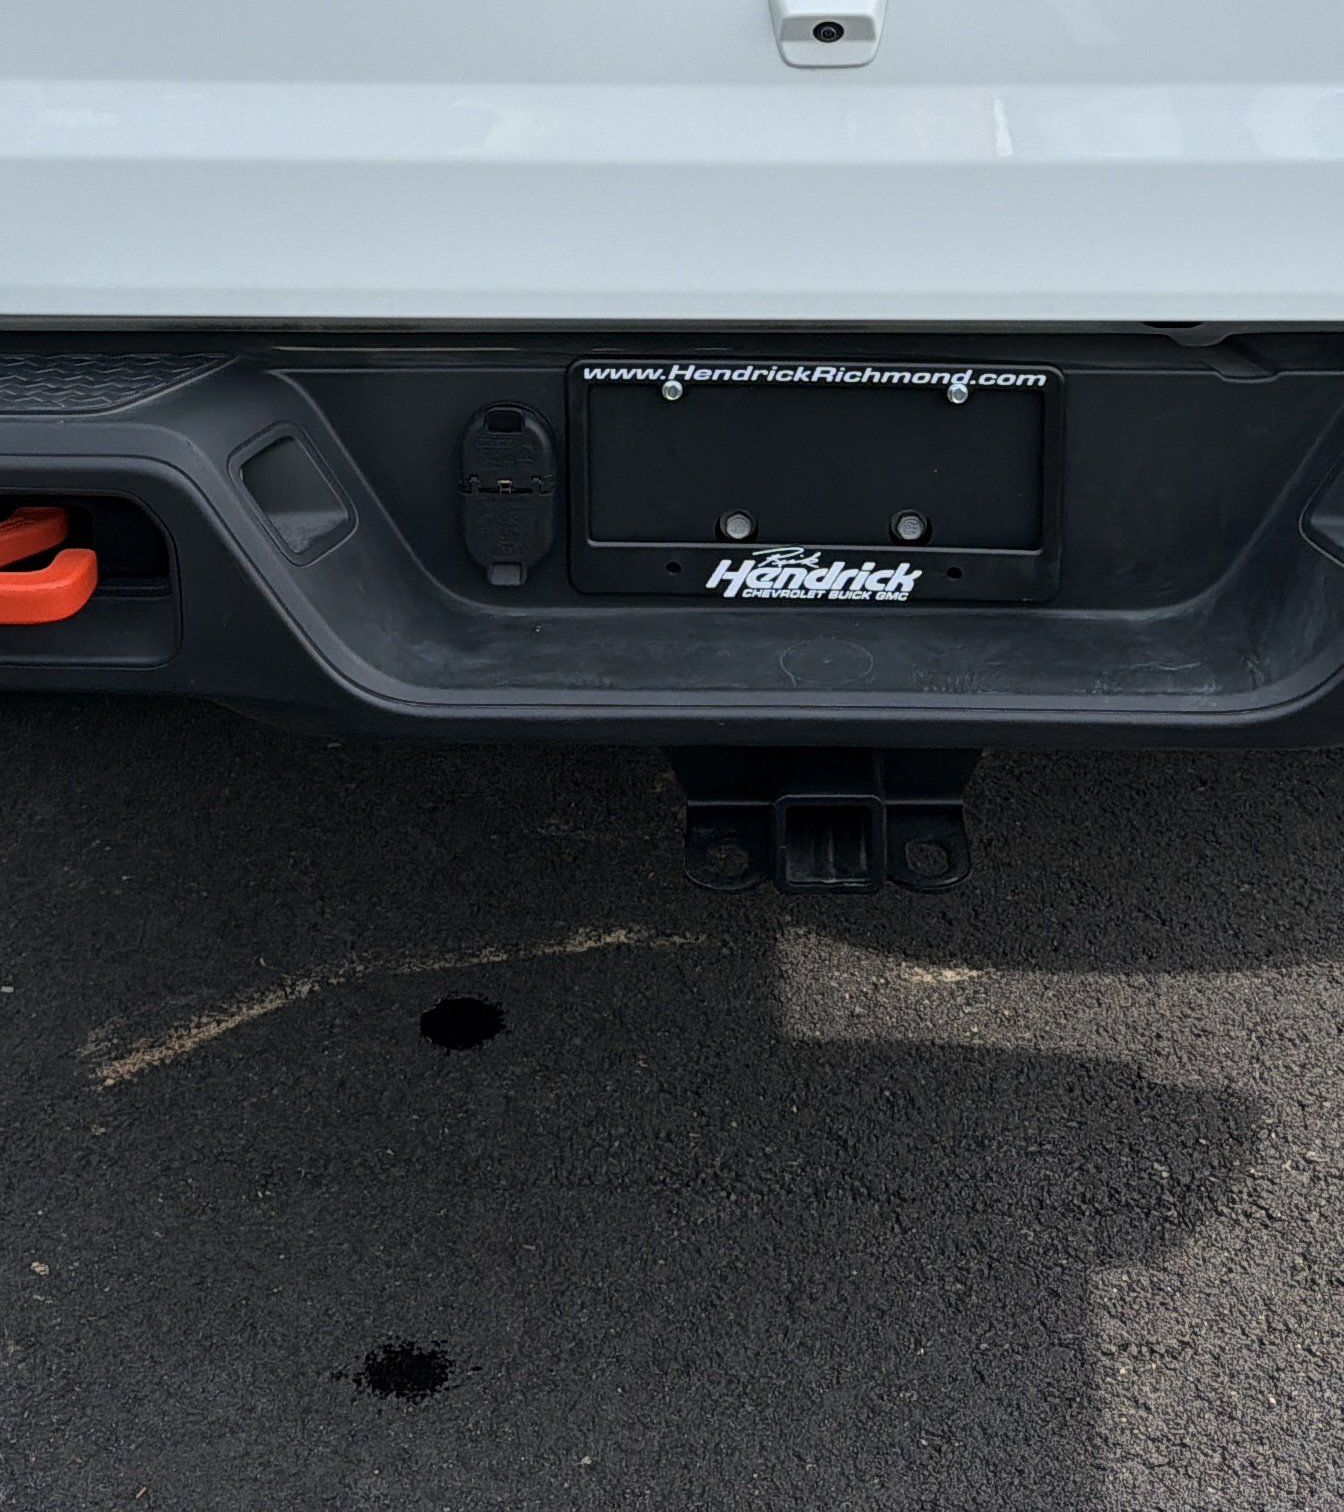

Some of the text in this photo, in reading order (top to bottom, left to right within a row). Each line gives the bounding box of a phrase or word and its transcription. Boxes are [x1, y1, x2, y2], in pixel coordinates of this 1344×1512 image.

[583, 364, 1047, 386] www.HendrickRichmond.com
[705, 559, 923, 598] Hendrick
[741, 589, 910, 601] CHEVROLET BUICK GMC
